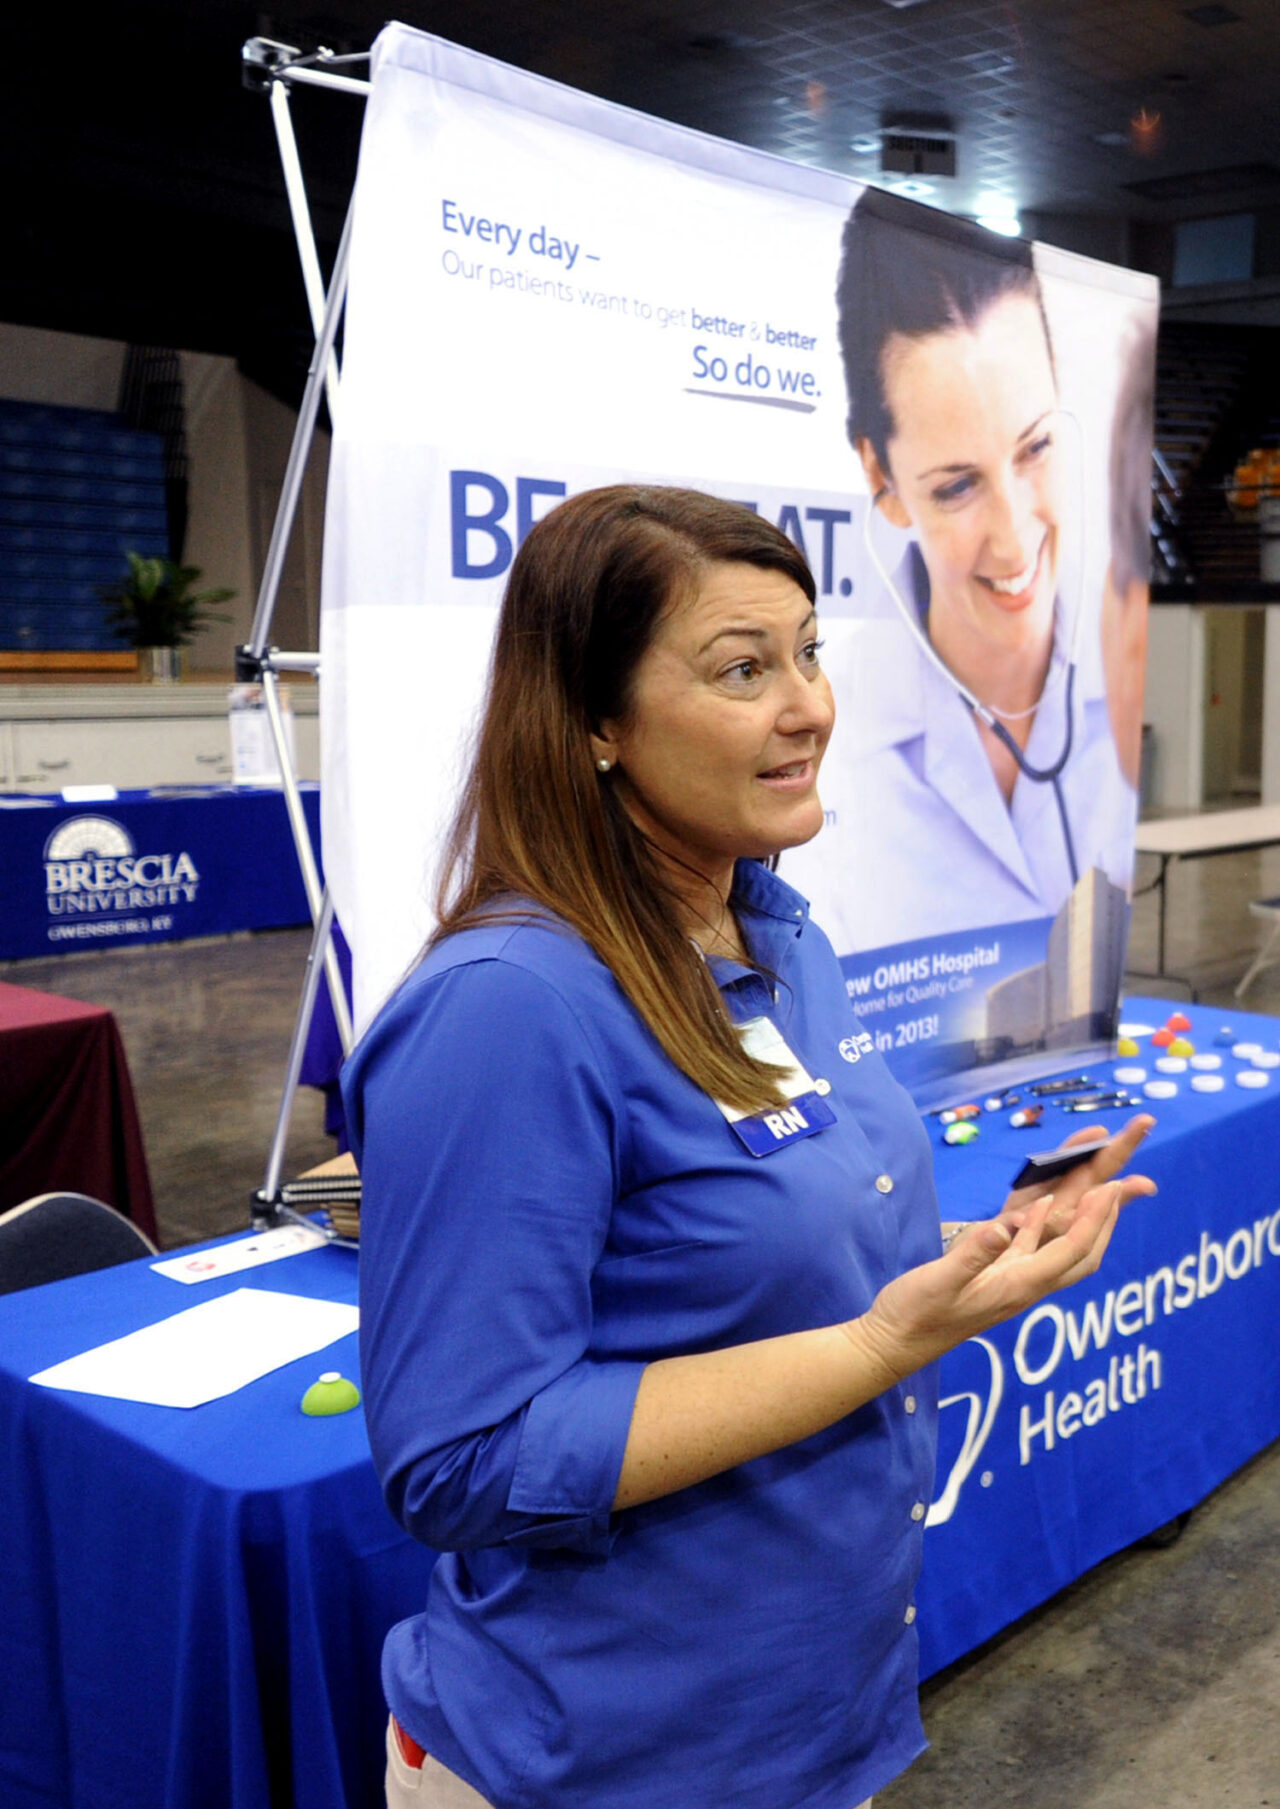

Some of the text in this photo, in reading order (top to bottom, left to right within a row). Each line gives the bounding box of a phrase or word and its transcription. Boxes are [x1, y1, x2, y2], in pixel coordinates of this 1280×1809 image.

[442, 199, 522, 256] Every
[529, 225, 580, 270] day
[442, 249, 483, 280] Our
[489, 267, 574, 302] patients
[578, 288, 628, 315] want
[633, 299, 652, 319] to
[656, 307, 686, 329] get
[691, 307, 746, 338] better
[766, 323, 817, 351] better
[692, 344, 822, 398] So do we.
[45, 852, 200, 894] BRESCIA
[47, 883, 199, 915] UNIVERSITY
[845, 942, 1000, 998] ew OMHS Hospital
[887, 989, 905, 1009] for
[905, 979, 948, 1004] Quality
[949, 975, 974, 994] Care
[875, 1030, 892, 1052] in
[895, 1014, 939, 1048] 2013!
[763, 1105, 809, 1140] RN
[1020, 1344, 1162, 1466] Health
